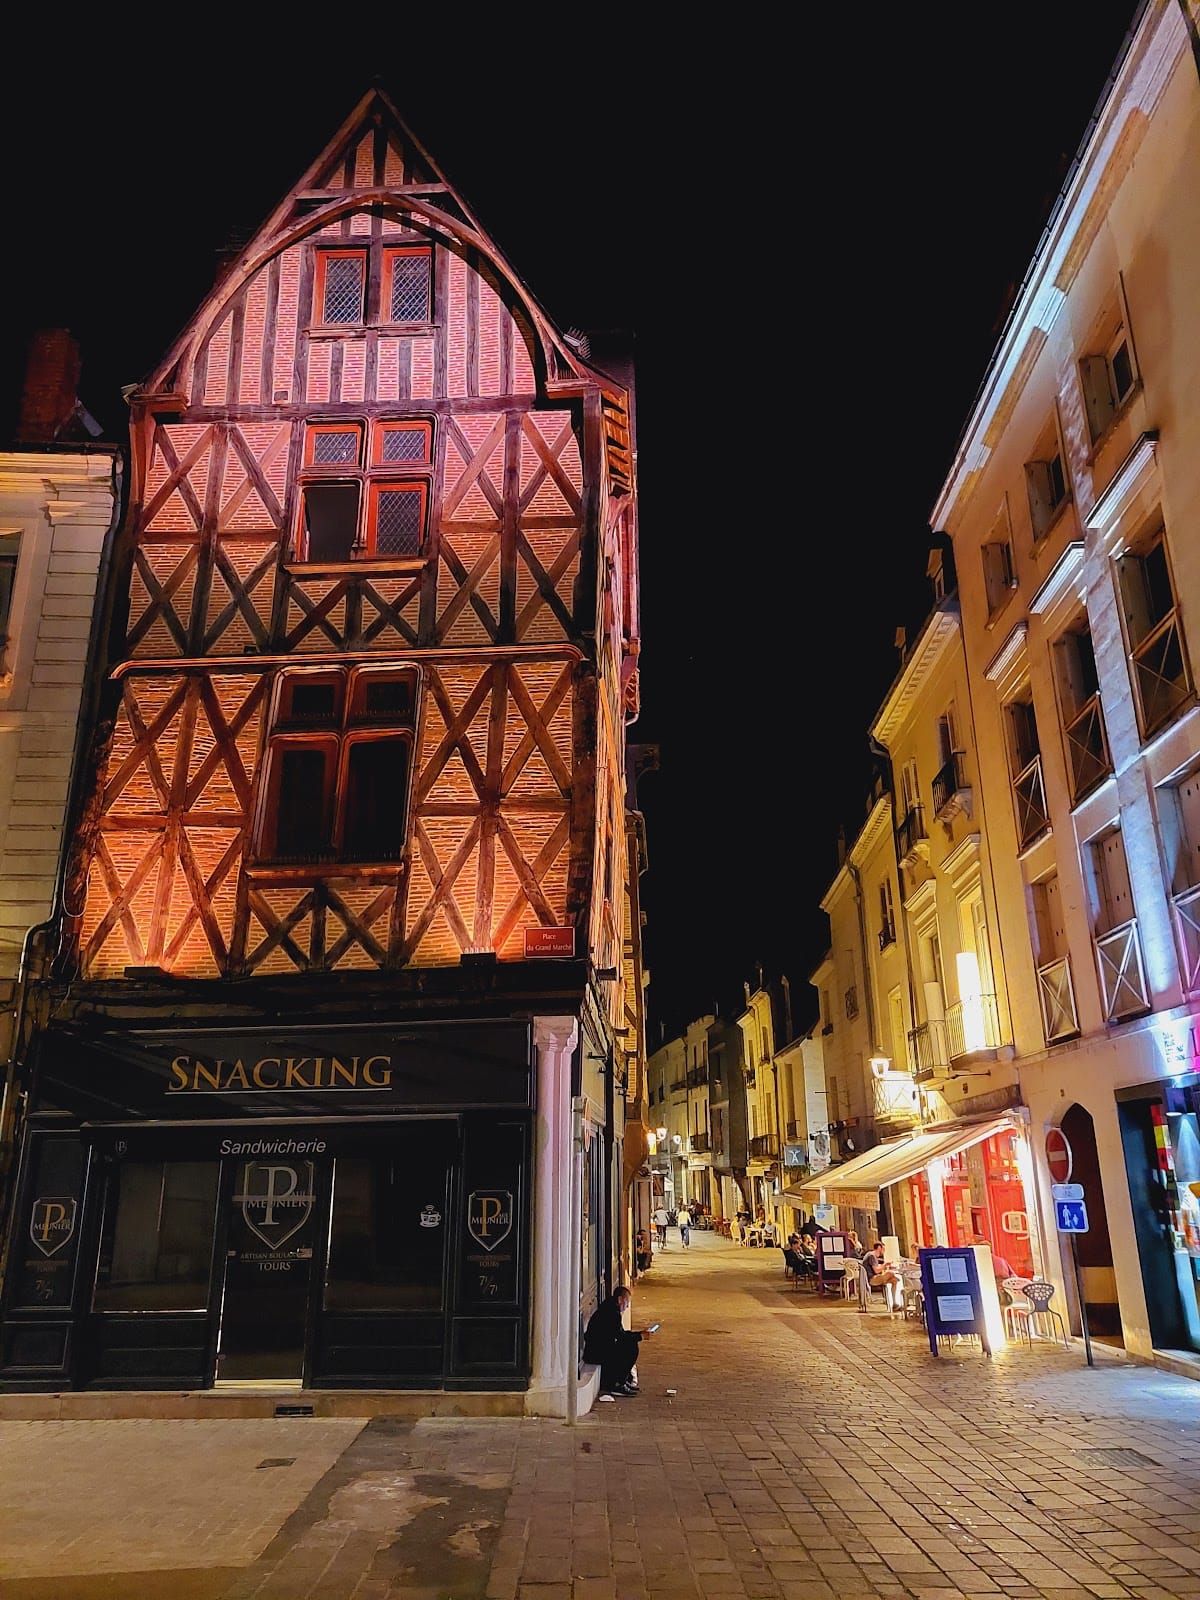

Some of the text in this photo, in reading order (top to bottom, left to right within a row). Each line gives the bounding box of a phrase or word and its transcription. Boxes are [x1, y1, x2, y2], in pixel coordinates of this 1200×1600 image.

[168, 1056, 393, 1091] SNACKING
[219, 1138, 327, 1155] Sandwicherie
[259, 1261, 292, 1271] TOURS
